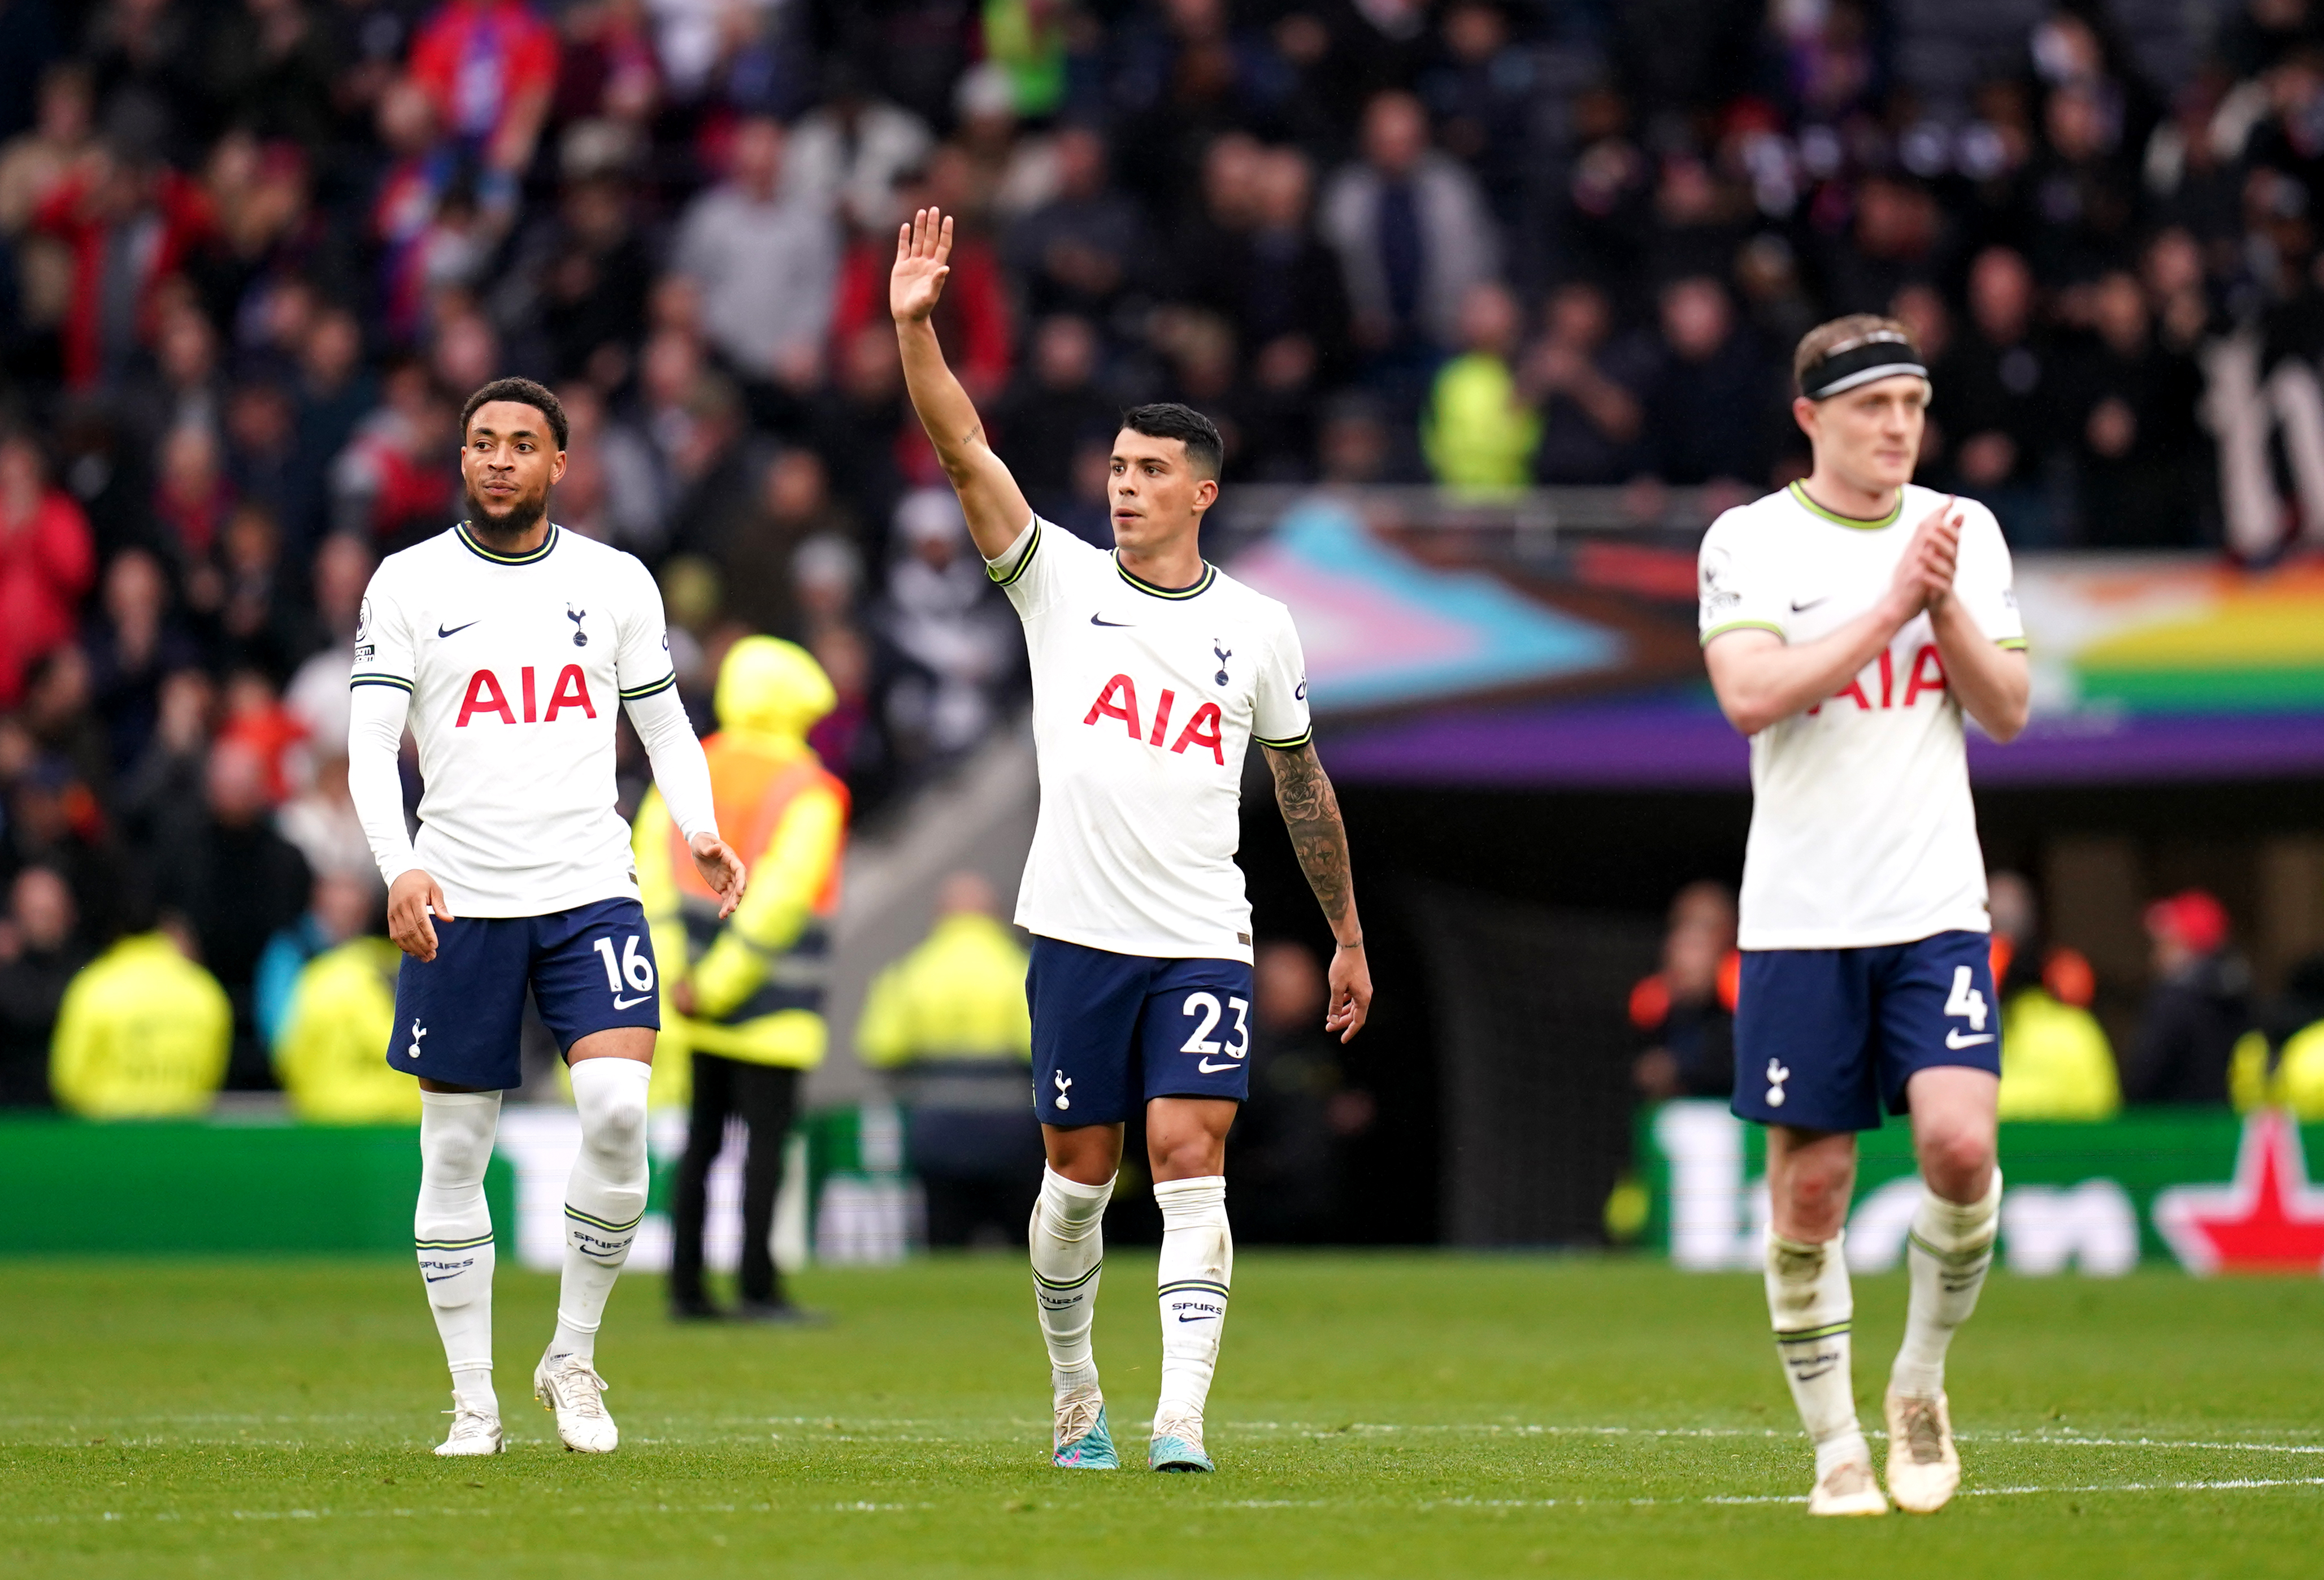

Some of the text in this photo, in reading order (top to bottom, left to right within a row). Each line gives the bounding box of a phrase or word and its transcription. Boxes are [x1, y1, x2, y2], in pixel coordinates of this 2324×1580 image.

[455, 664, 597, 728] AIA
[1083, 674, 1224, 766] AIA
[594, 935, 654, 992] 16
[1180, 992, 1249, 1059] 23
[1944, 965, 1988, 1031] 4
[419, 1258, 474, 1270] SPURS
[574, 1231, 633, 1249] SPURS
[1172, 1303, 1223, 1315] SPURS
